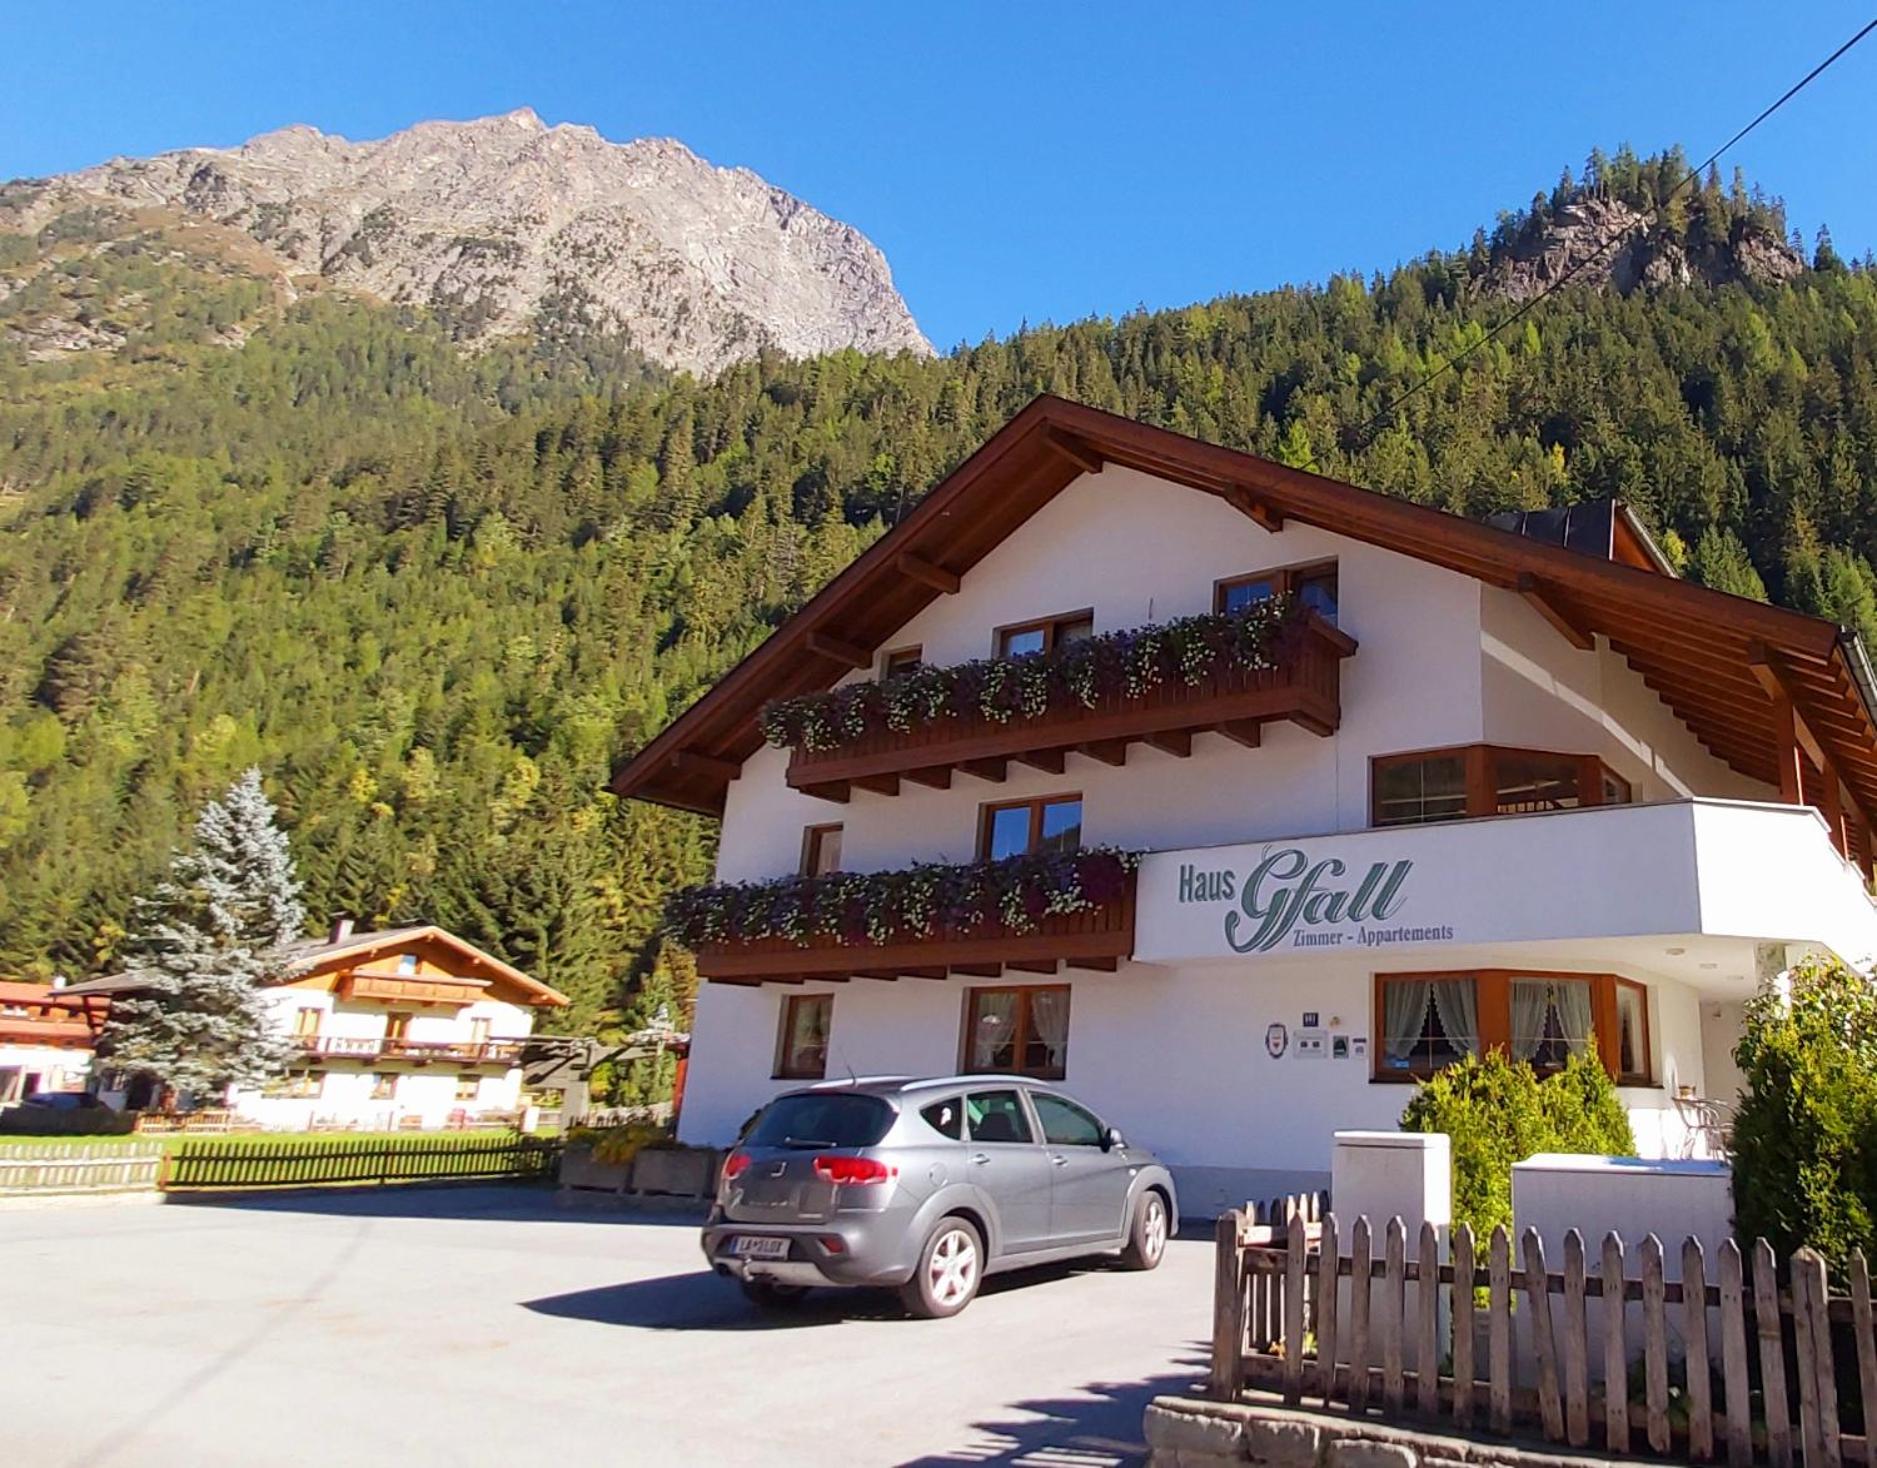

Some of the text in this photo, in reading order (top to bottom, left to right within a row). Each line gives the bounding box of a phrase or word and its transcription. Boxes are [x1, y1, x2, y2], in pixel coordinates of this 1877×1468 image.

[1179, 846, 1414, 953] Haus Gfall
[1293, 929, 1343, 947] Zimmer
[1357, 924, 1454, 946] Appartements
